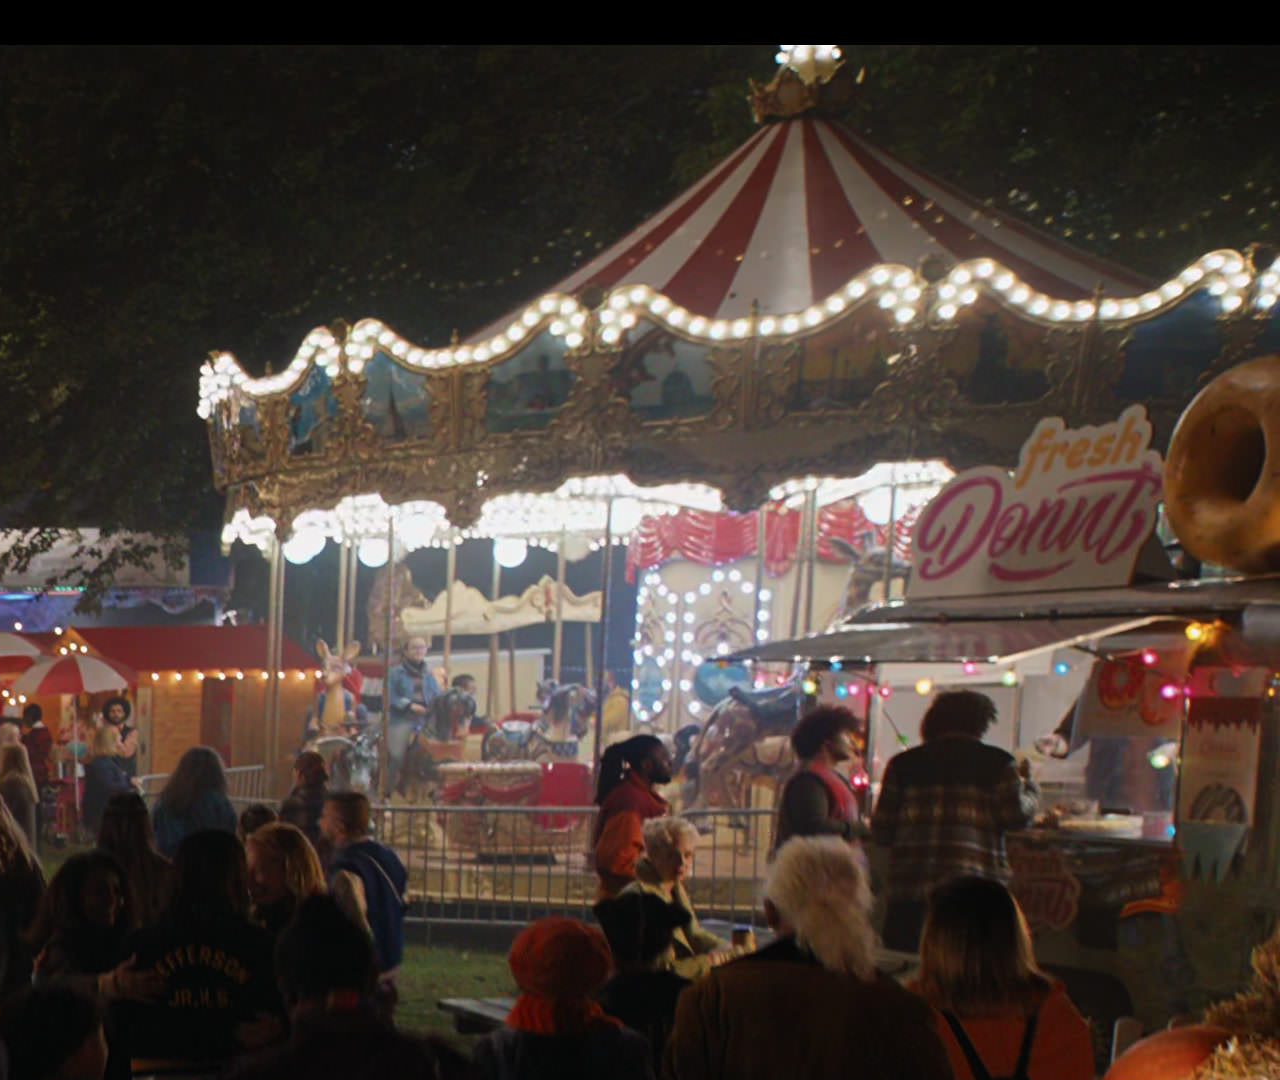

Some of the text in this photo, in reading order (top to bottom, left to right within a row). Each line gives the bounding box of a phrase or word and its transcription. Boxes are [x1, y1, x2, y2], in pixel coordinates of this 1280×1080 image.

[1015, 416, 1142, 490] fresh
[917, 462, 1164, 581] Donut
[150, 943, 252, 985] EFFERSON
